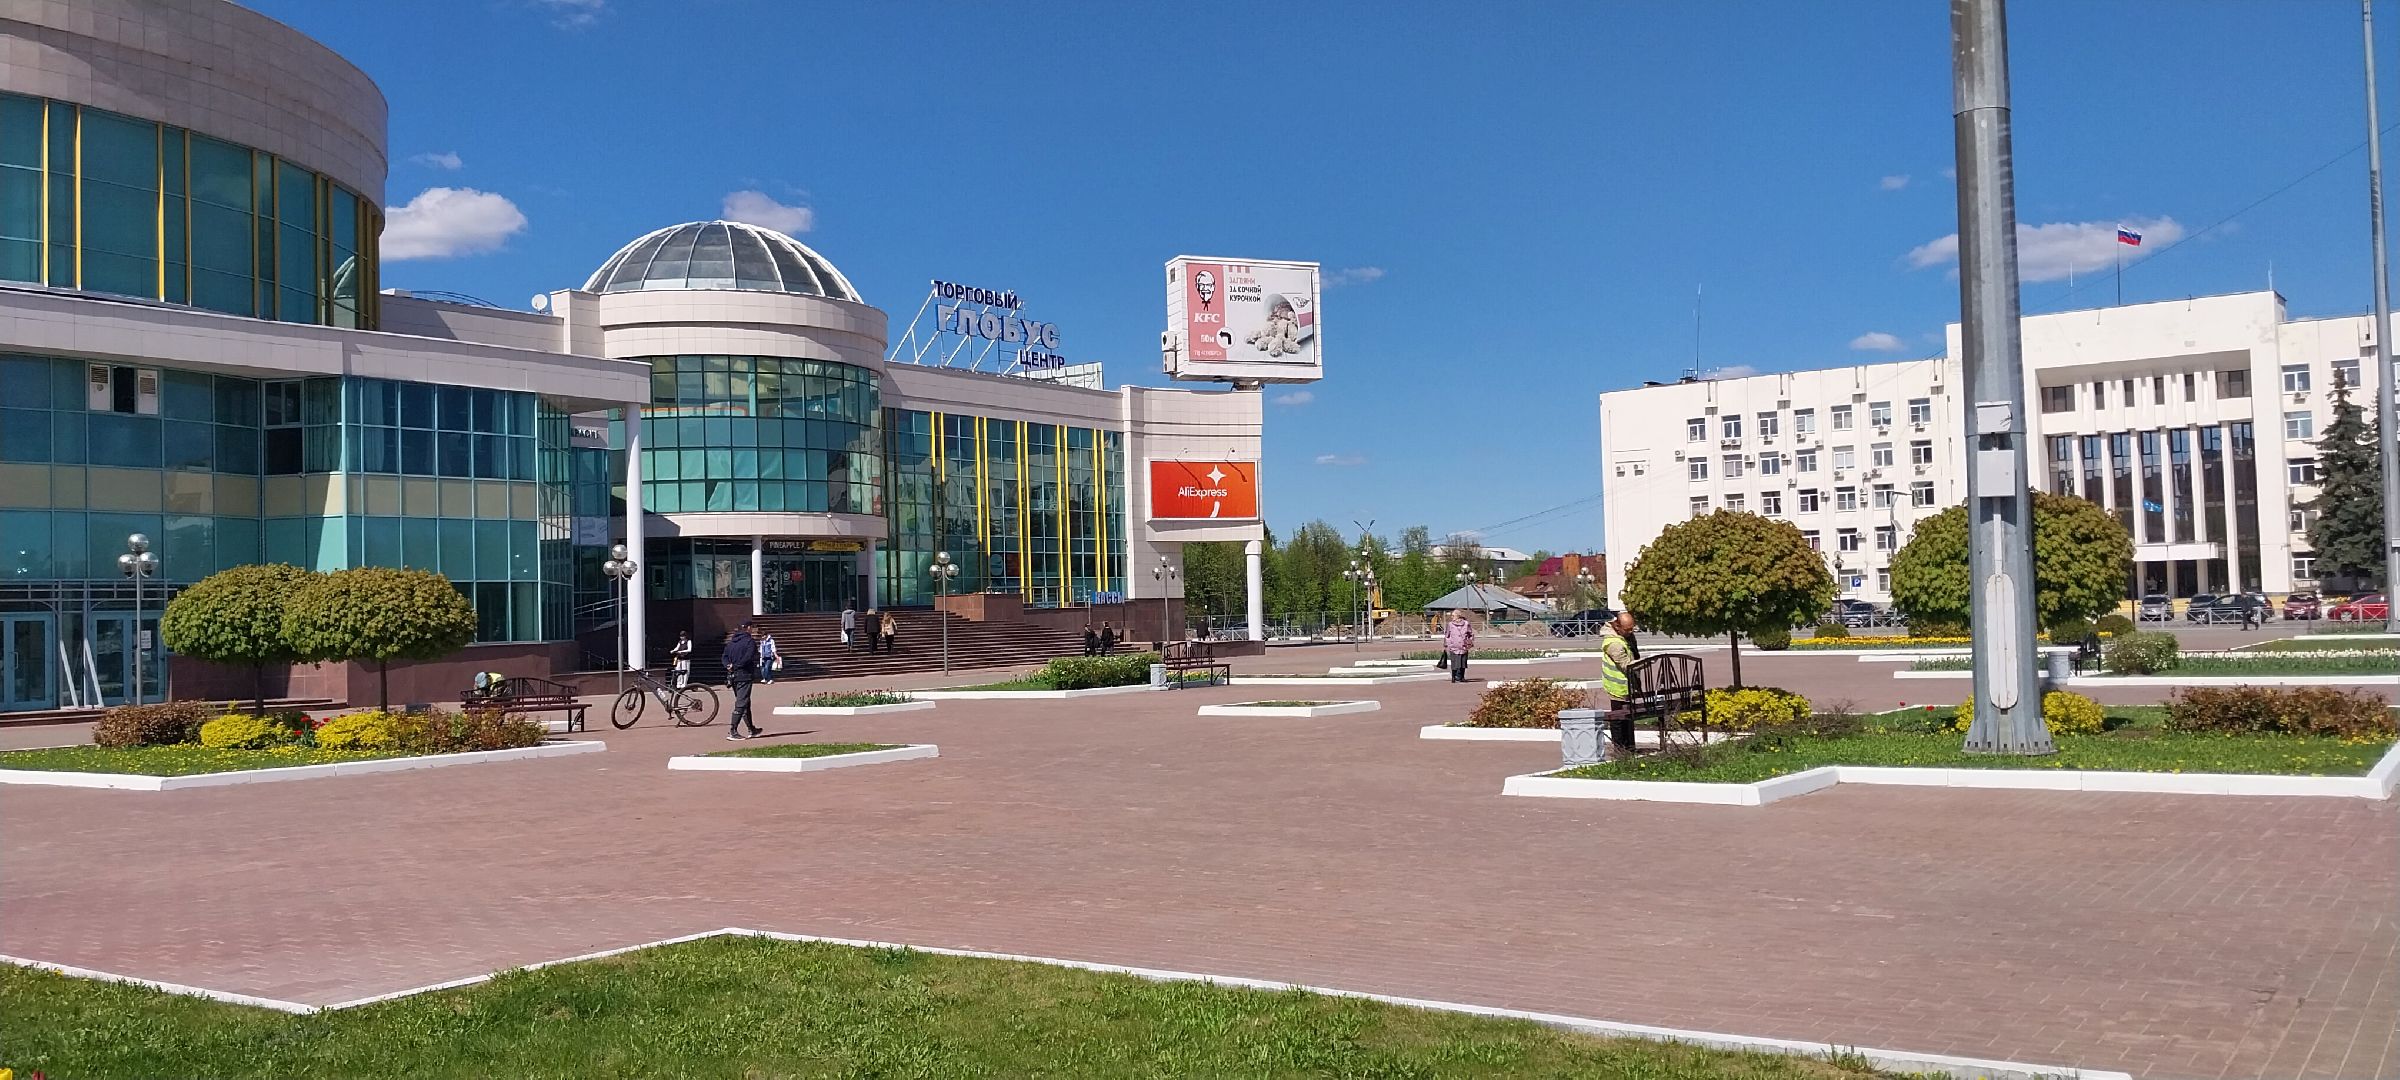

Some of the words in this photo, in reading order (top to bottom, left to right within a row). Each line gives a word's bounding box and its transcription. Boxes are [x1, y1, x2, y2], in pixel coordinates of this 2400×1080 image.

[931, 280, 1018, 310] ТОРГОВЫЙ
[1229, 285, 1237, 293] ЗА
[1229, 293, 1261, 302] КУРОЧКОЙ
[1194, 312, 1221, 323] KFC
[936, 304, 1060, 349] ГЛОБУС
[1018, 349, 1065, 370] ЦЕНТР
[1178, 486, 1228, 500] AliExpress
[1854, 578, 1861, 586] P
[1094, 591, 1125, 604] КАССЫ
